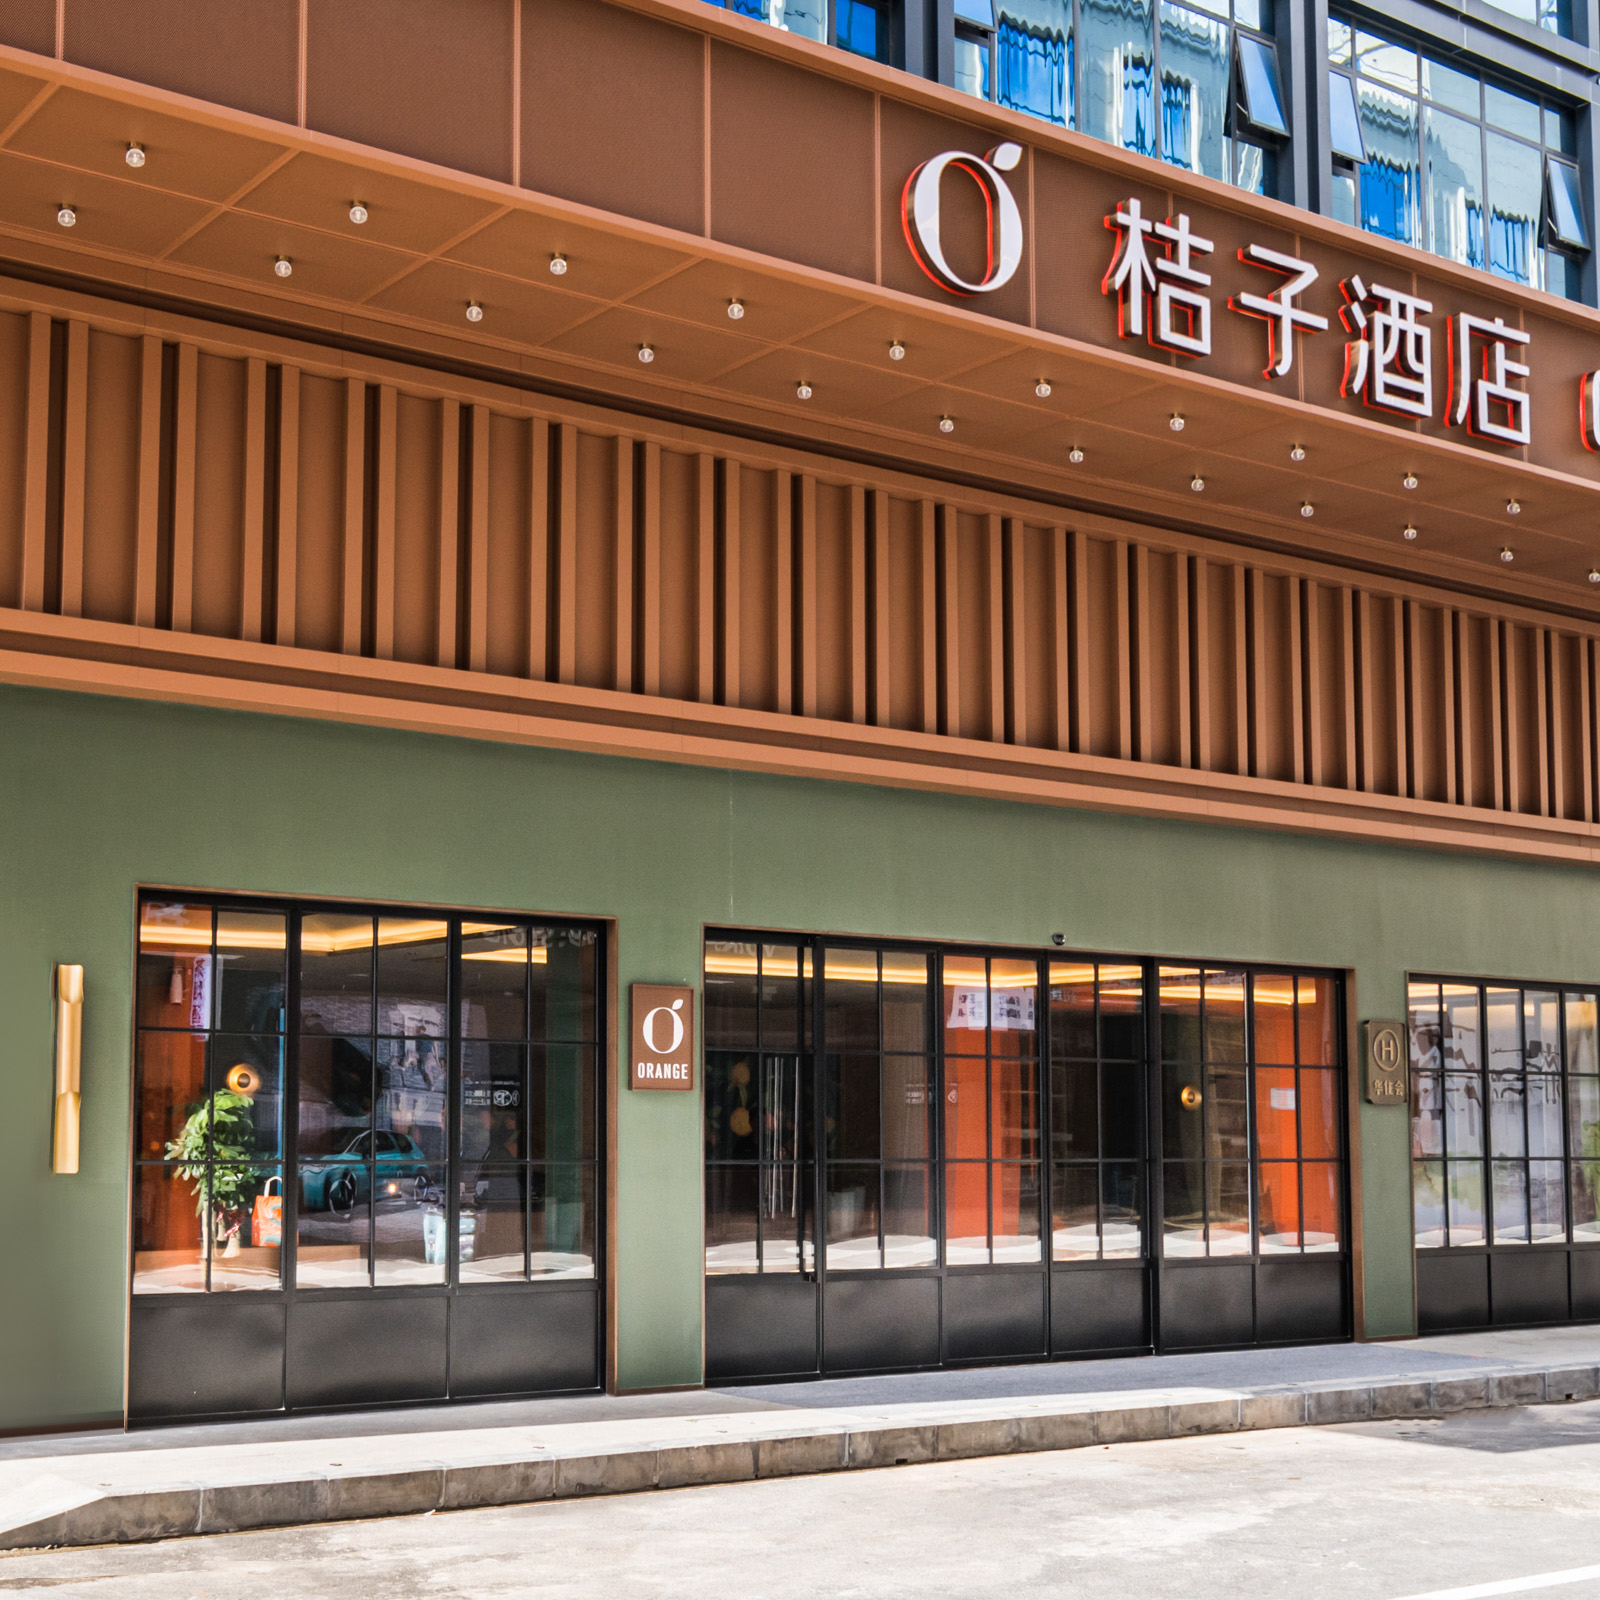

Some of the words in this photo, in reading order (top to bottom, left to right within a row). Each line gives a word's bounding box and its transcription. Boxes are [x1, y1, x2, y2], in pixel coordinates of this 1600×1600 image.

[1102, 197, 1531, 446] 桔子酒店
[637, 1062, 689, 1080] ORANGE
[1374, 1079, 1404, 1097] 华住会
